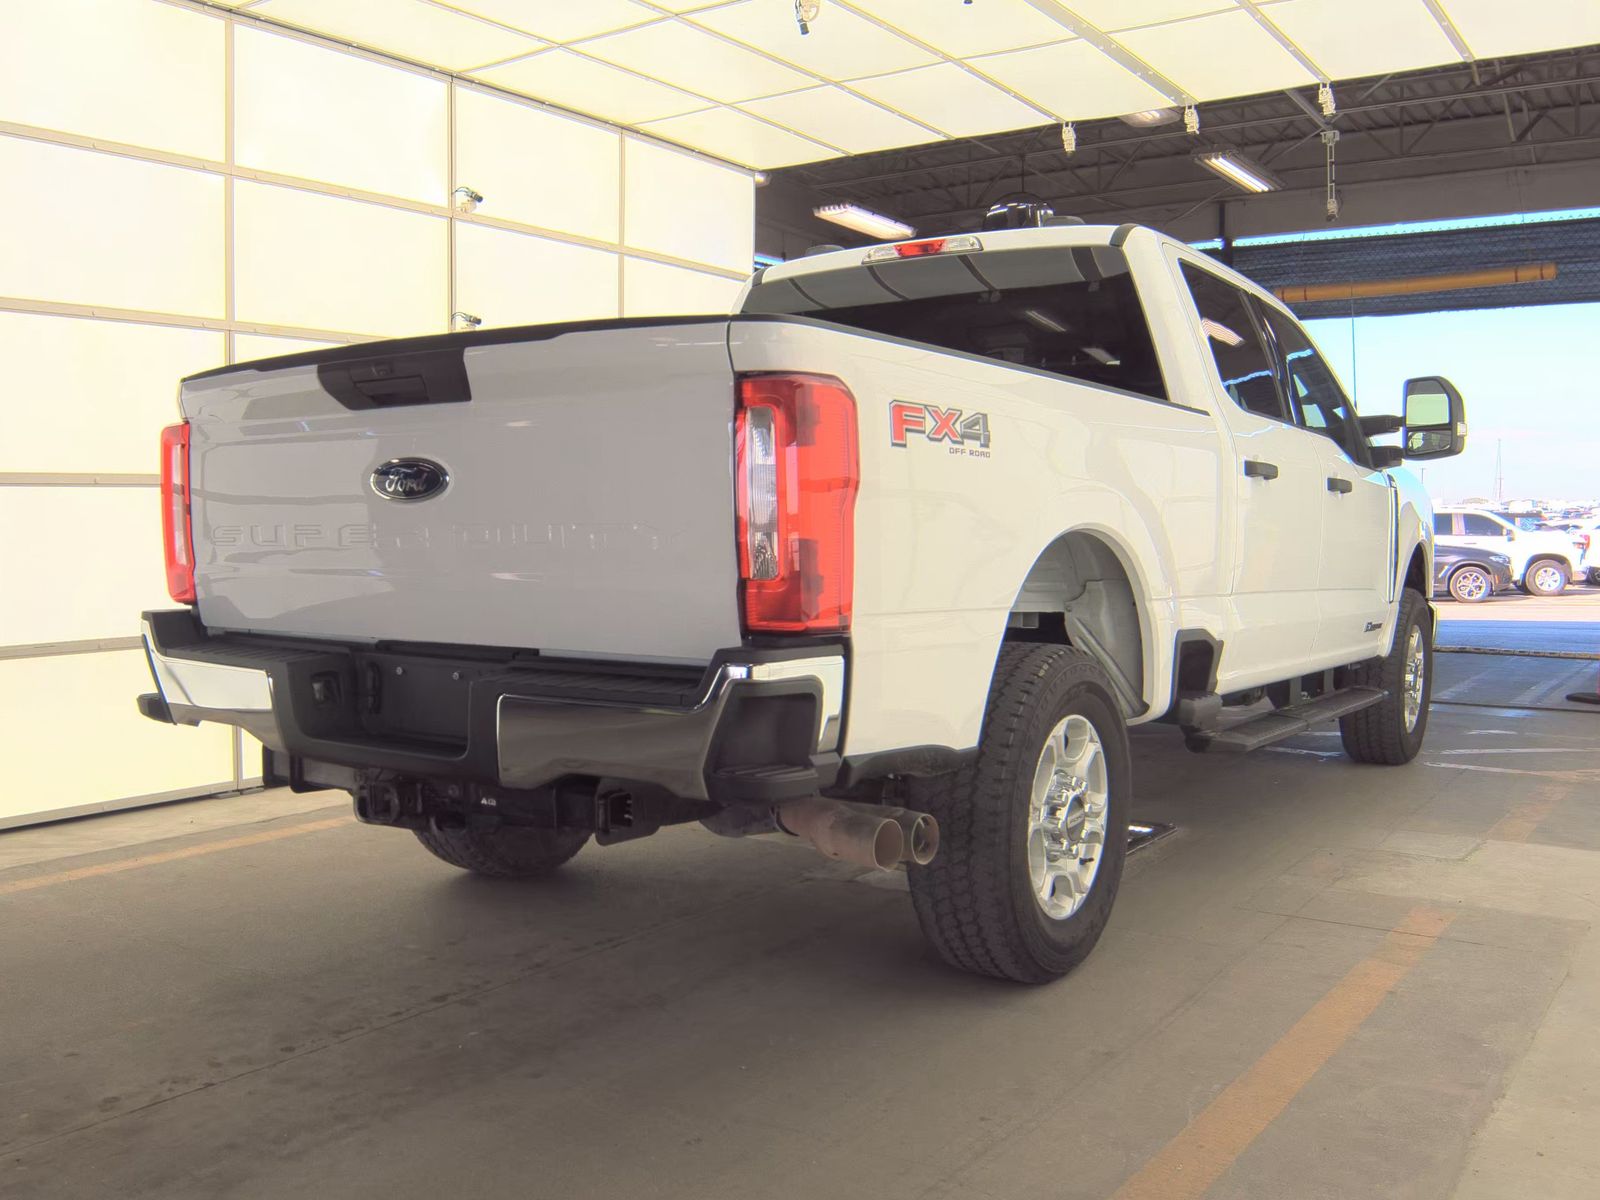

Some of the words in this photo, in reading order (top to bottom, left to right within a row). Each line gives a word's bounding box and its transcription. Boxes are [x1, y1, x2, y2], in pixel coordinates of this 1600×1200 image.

[889, 399, 990, 448] FX4
[949, 447, 967, 456] OFF
[969, 449, 991, 458] ROAD
[386, 467, 428, 492] Ford
